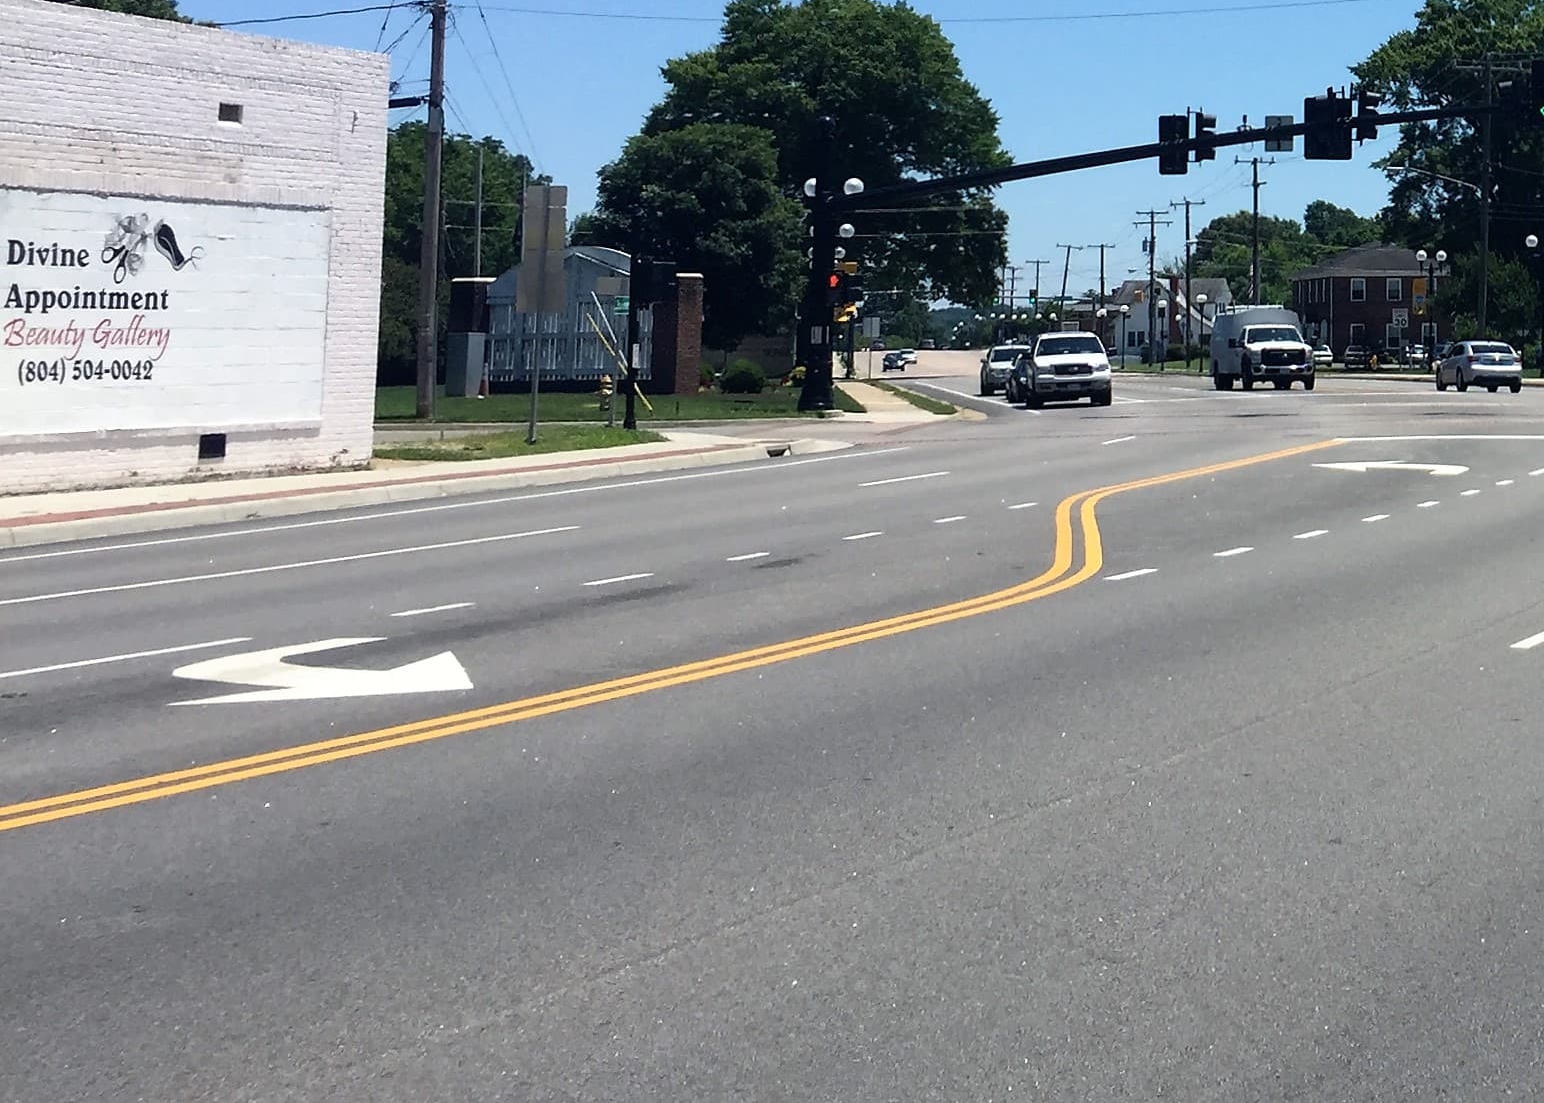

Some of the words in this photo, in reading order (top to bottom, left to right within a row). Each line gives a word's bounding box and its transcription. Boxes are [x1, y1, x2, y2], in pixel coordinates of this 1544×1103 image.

[7, 239, 90, 267] Divine
[4, 283, 169, 314] Appointment
[1394, 318, 1407, 327] 30
[3, 318, 86, 361] Beauty
[92, 314, 171, 361] Gallery
[18, 357, 66, 386] (804)
[72, 359, 154, 381] 504-0042
